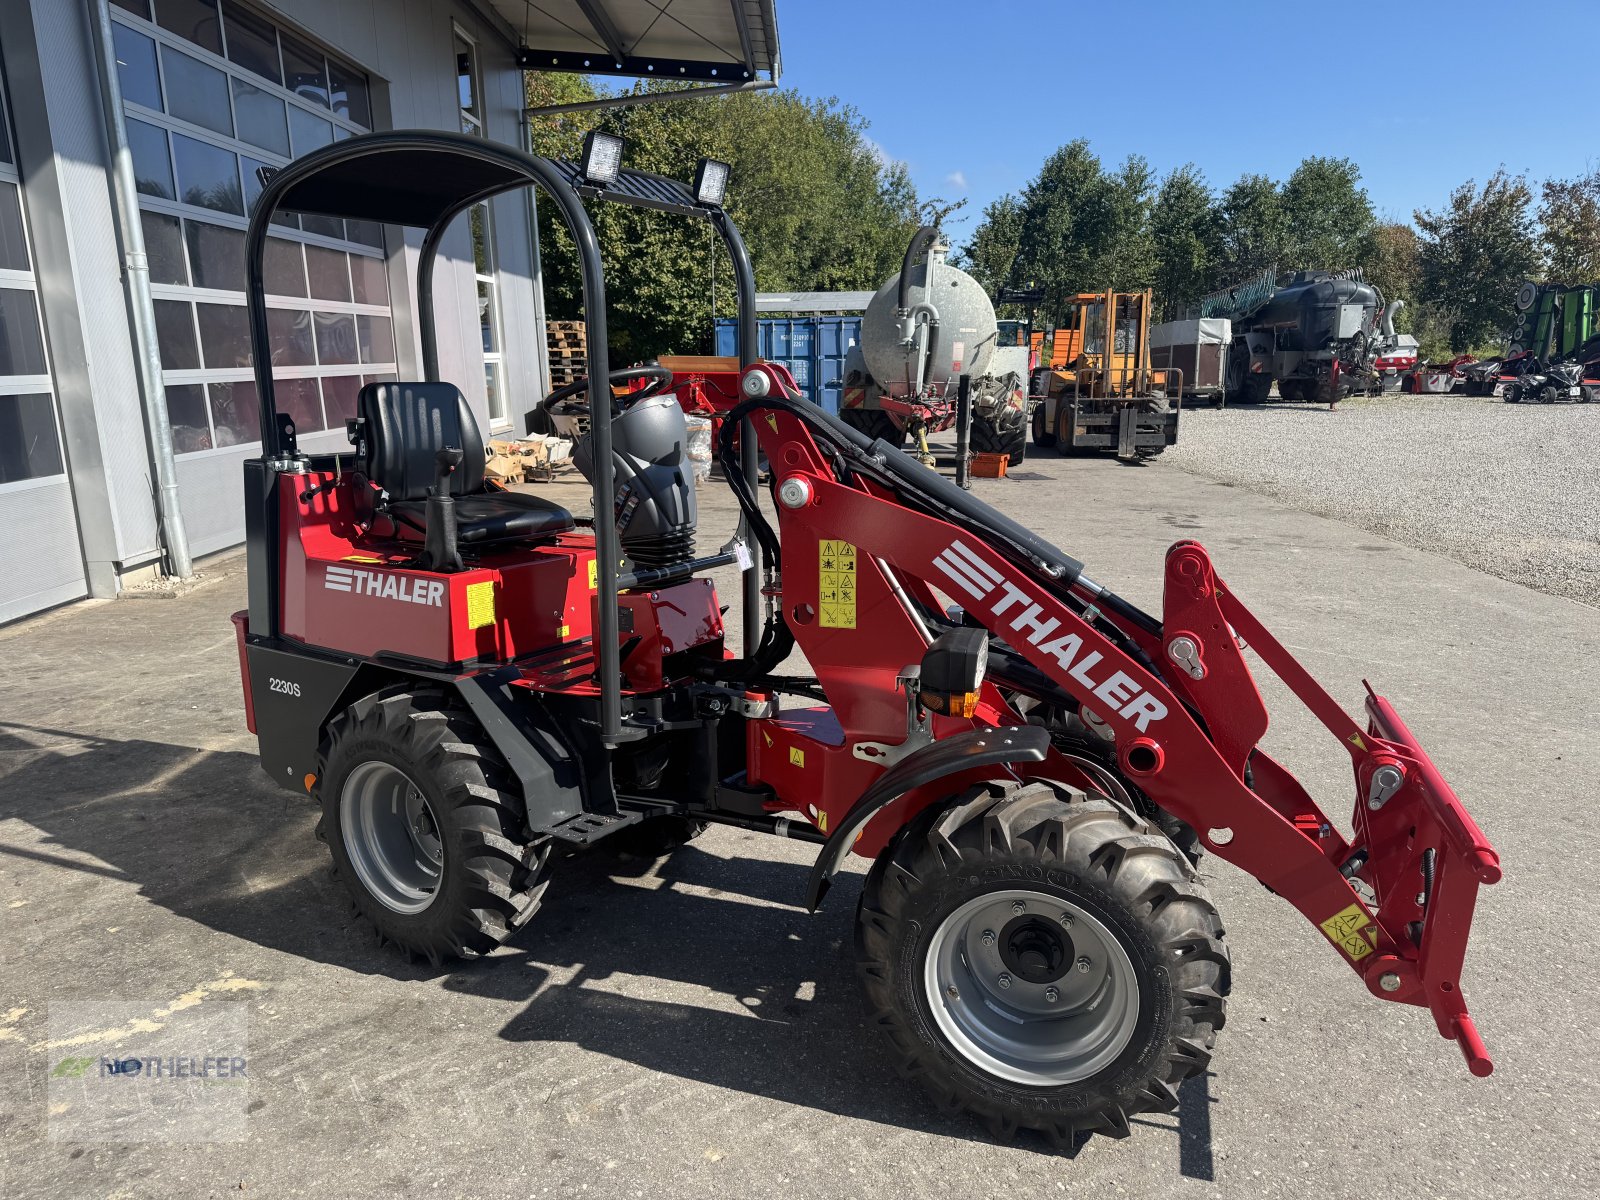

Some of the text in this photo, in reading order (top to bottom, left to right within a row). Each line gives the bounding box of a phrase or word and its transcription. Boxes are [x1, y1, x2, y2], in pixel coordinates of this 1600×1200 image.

[353, 569, 445, 608] THALER
[990, 580, 1169, 734] THALER
[268, 677, 302, 698] 2230S
